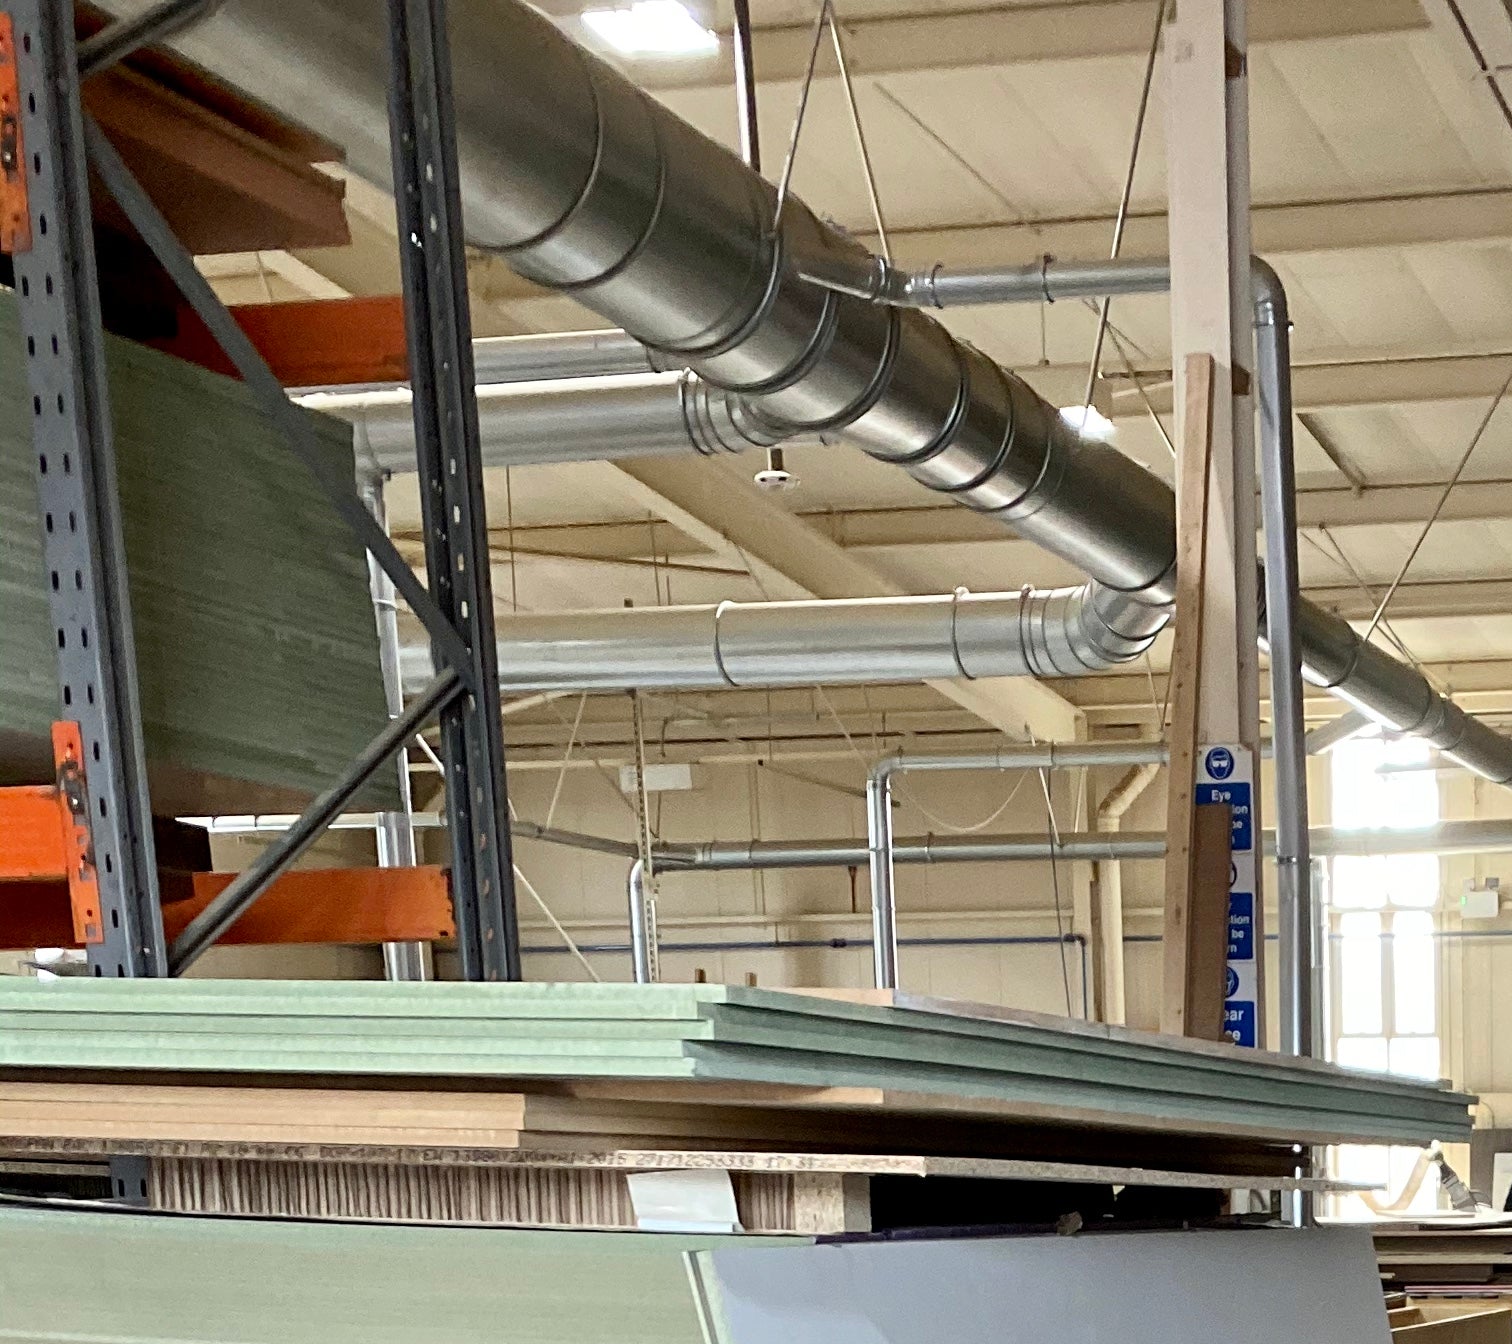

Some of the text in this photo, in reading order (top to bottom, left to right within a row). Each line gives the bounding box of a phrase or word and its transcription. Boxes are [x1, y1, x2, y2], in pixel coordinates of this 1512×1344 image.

[1211, 789, 1232, 802] Eye
[1231, 928, 1245, 939] be
[1224, 1009, 1245, 1021] ear
